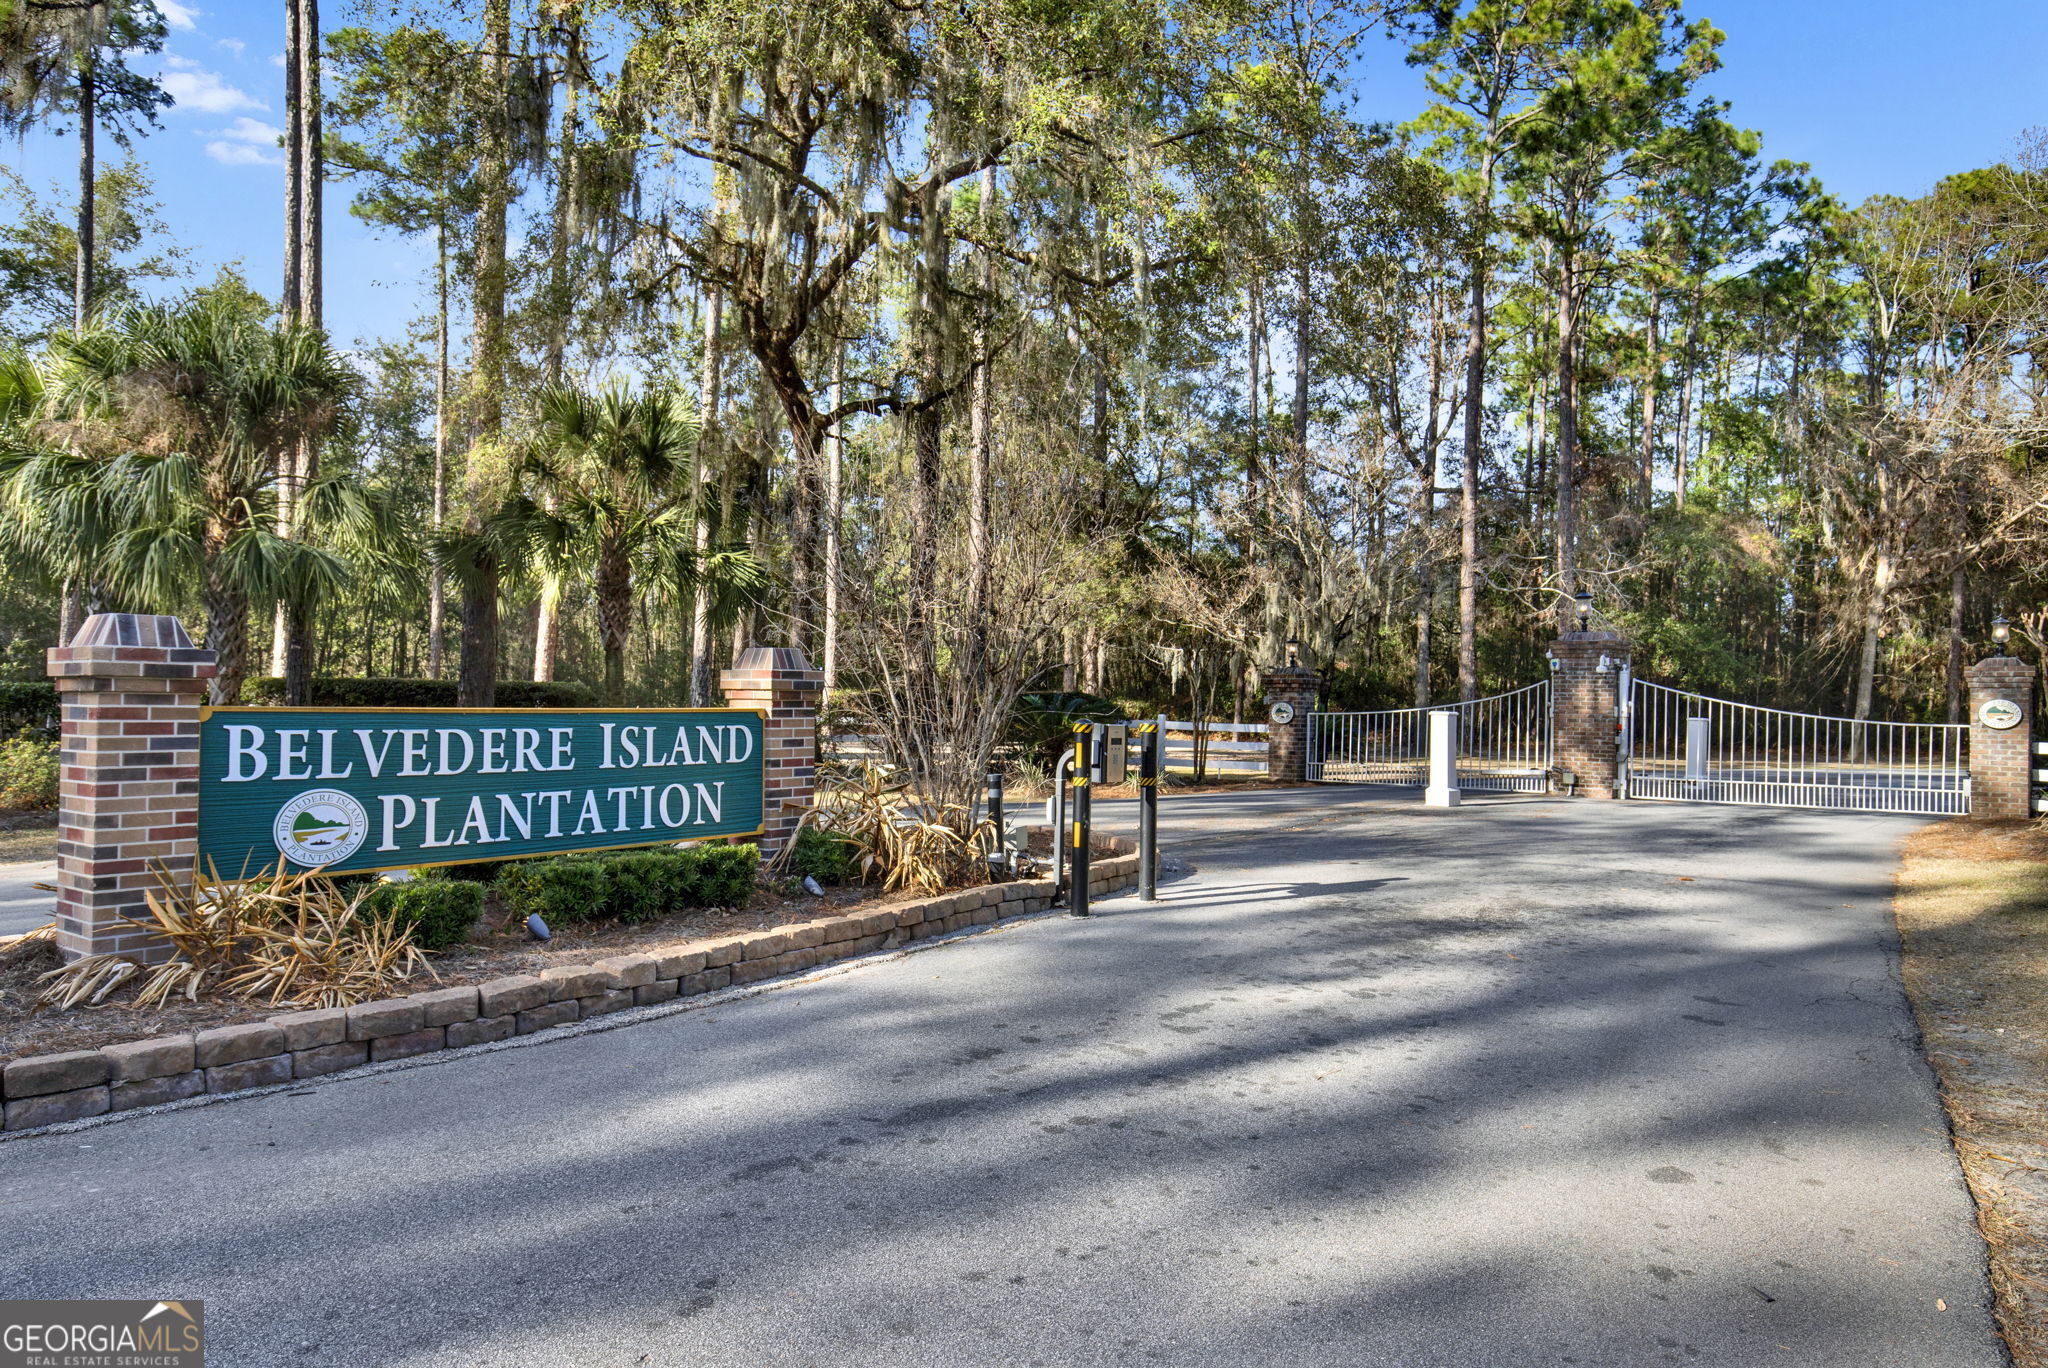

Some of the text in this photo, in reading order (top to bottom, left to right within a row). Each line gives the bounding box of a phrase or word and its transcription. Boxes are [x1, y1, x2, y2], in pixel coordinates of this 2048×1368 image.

[220, 722, 754, 782] BELVEDERE ISLAND
[280, 794, 364, 832] BELVEDERE ISLAND
[376, 781, 725, 851] PLANTATION
[287, 840, 355, 862] PLANTATION
